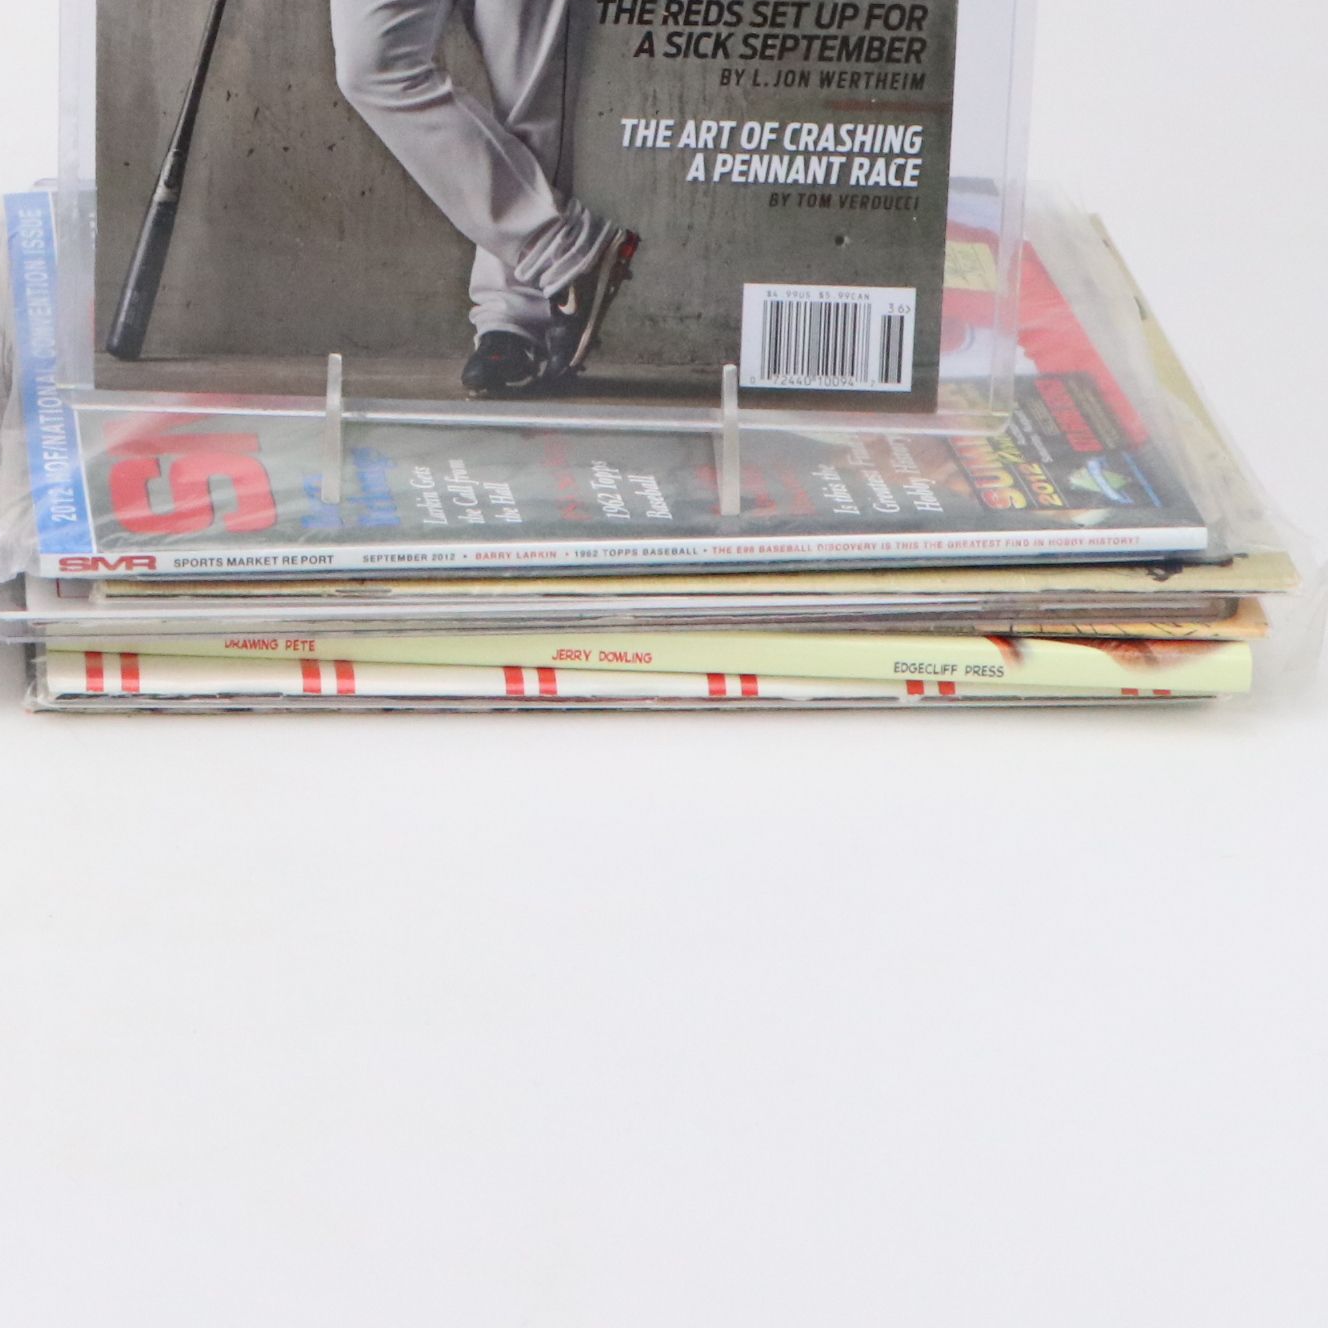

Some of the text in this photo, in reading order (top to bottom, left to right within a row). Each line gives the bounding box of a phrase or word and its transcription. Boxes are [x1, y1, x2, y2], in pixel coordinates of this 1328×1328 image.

[664, 0, 744, 27] REDS
[750, 0, 810, 28] SET
[814, 2, 860, 30] UP
[865, 3, 929, 31] FOR
[633, 30, 928, 64] A SICK SEPTEMBER
[721, 69, 926, 91] BY L. JON WERTHEIM
[621, 118, 923, 154] THE ART OF CRASHING
[686, 153, 922, 187] A PENNANT RACE
[769, 192, 920, 211] BY TOM VERDUCCI
[18, 210, 77, 522] 2012 ISSUE
[483, 482, 516, 504] Hall
[627, 475, 672, 520] Baseball
[1017, 463, 1064, 507] 2012
[597, 493, 630, 520] 1962
[59, 537, 1083, 572] SMR SPORTS MARKET REPORT SEPTEMBER 2012 BARRY LARKIN 1962 TOPPS BASEBALL THE BASEBALL DISCOVERY THIS THE GREATEST FIND HOBBY
[224, 639, 316, 652] DRAWING PETE
[552, 648, 652, 664] JERRY DOWLING
[894, 661, 1005, 678] EDGECLIFF PRESS
